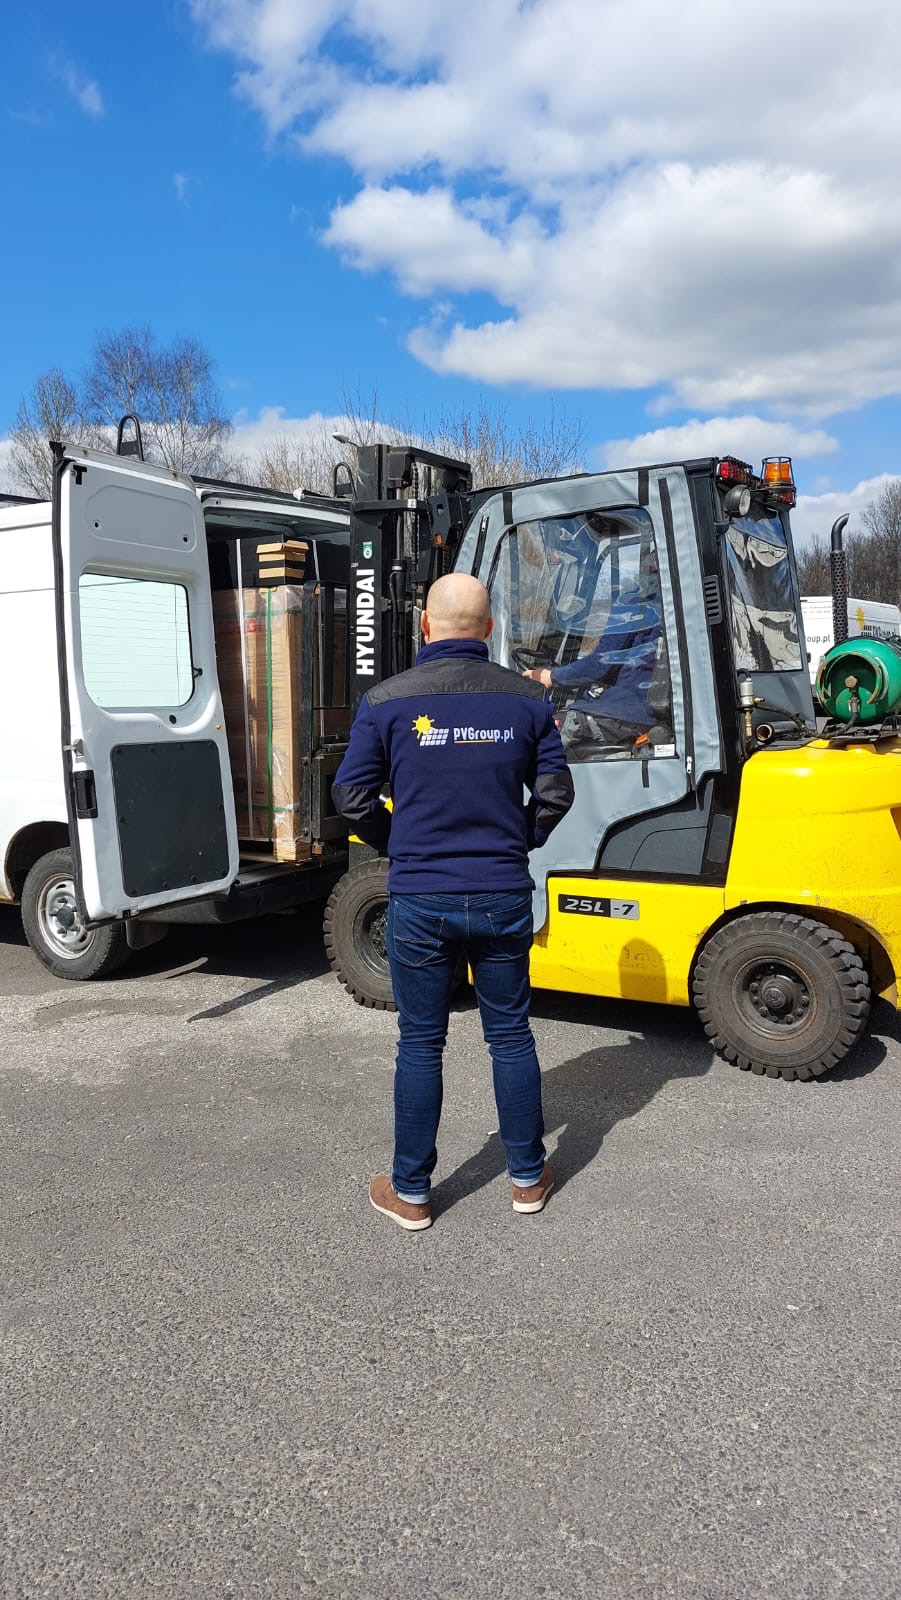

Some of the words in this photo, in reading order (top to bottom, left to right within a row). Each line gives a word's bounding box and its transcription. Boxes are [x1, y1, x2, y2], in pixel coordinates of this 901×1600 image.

[356, 568, 375, 676] HYUNDAI
[805, 634, 831, 644] oup.pl
[453, 727, 514, 743] PVGroup.pl
